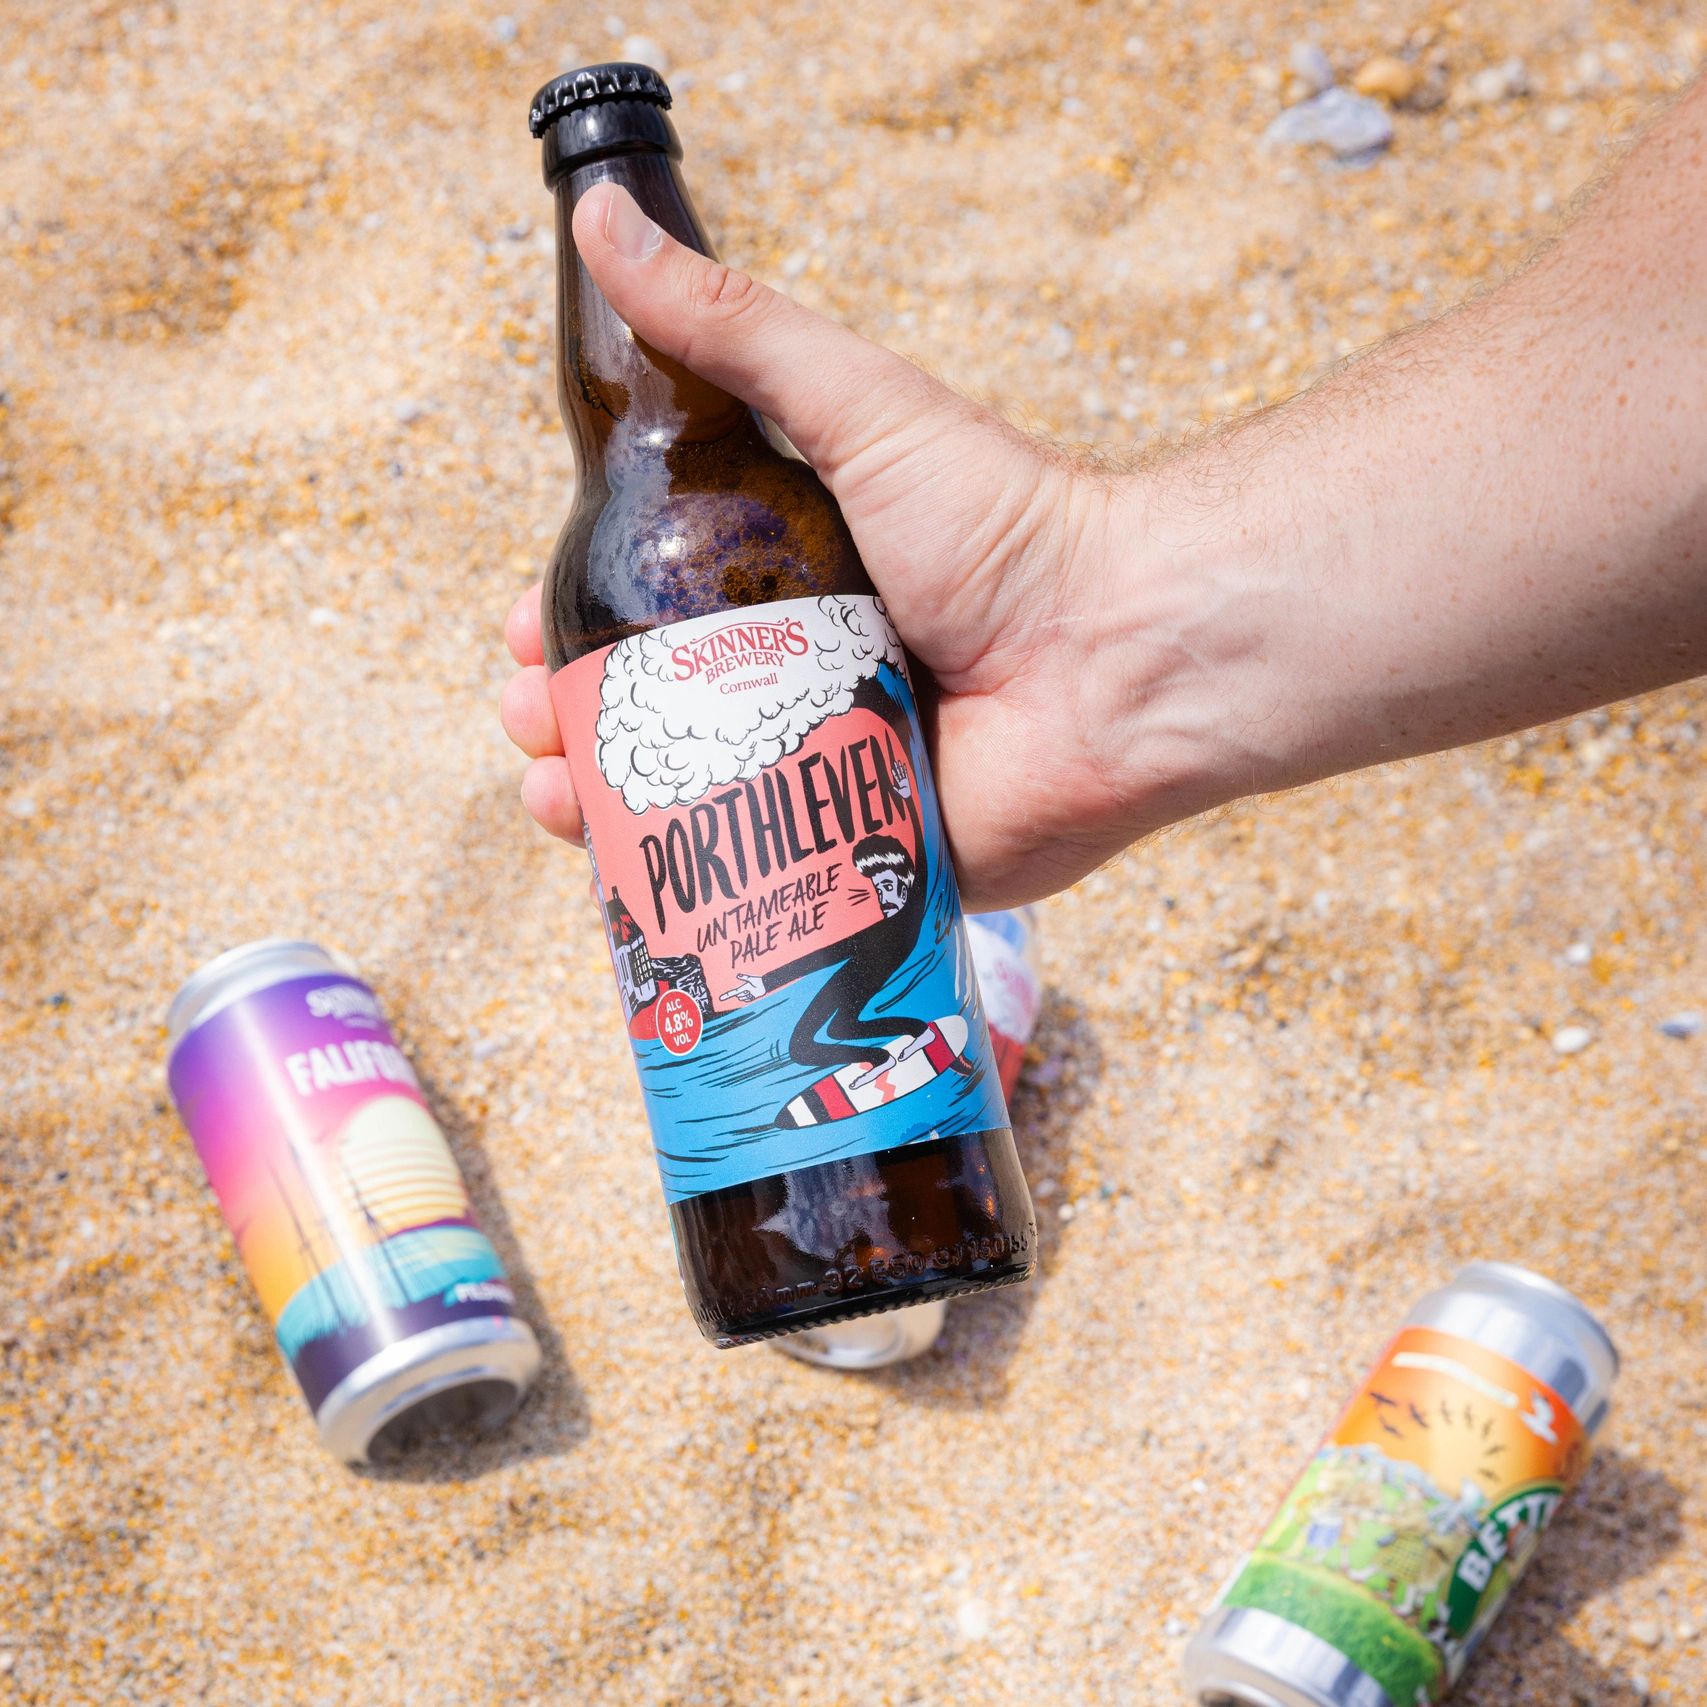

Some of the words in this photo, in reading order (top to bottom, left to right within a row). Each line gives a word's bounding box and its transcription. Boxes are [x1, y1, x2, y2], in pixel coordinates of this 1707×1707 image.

[671, 617, 809, 681] SKINNER'S
[705, 651, 785, 685] BREWERY
[719, 672, 779, 695] Cornwall
[639, 730, 907, 935] PORTHLEVEN
[697, 863, 843, 953] UNTAMEABLE
[730, 921, 782, 969] PALE
[787, 901, 829, 942] ALE
[665, 998, 682, 1014] ALC
[665, 1010, 694, 1035] 4.8%
[673, 1032, 692, 1047] VOL
